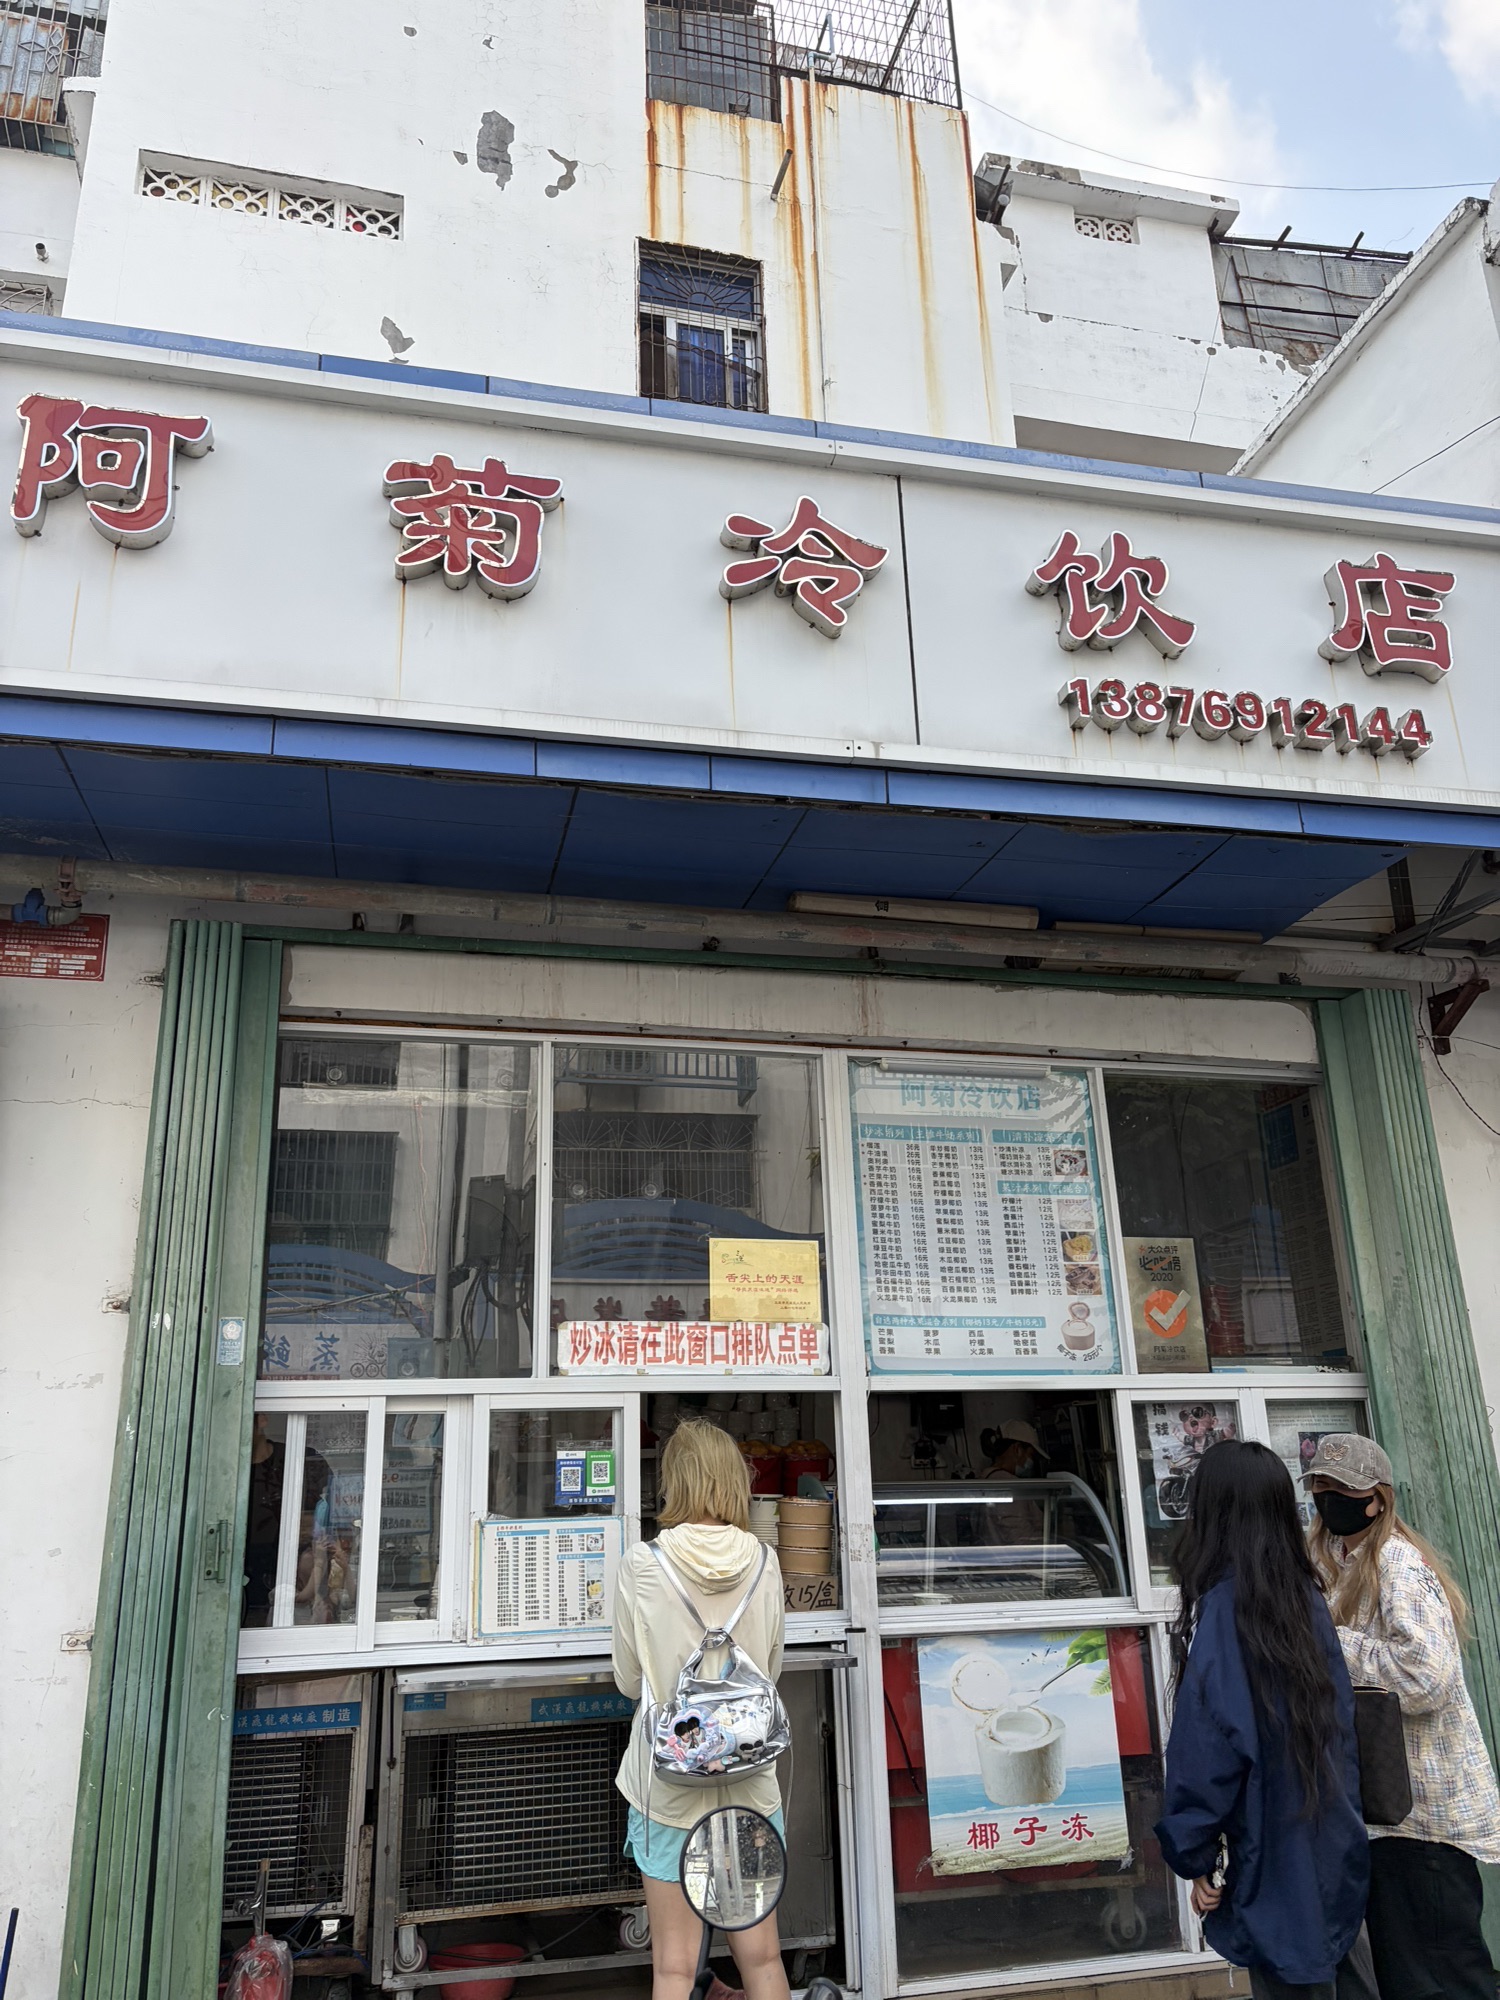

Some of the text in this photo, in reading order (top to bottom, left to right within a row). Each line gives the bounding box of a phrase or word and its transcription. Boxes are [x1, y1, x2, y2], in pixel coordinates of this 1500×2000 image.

[10, 392, 1457, 678] 阿菊冷饮店
[1062, 676, 1433, 755] 13876912144
[901, 1079, 1041, 1110] 阿菊冷饮店
[1148, 1245, 1178, 1254] 大众点评
[1139, 1255, 1181, 1271] 必吃榜
[726, 1273, 804, 1284] 舌尖上的天涯
[1151, 1273, 1173, 1281] 2020
[877, 1294, 913, 1302] 火龙果牛奶
[1013, 1330, 1036, 1338] 番石榴
[569, 1322, 820, 1366] 炒冰请在此窗口排队点单
[970, 1348, 994, 1356] 火龙果
[967, 1812, 1095, 1852] 椰子冻
